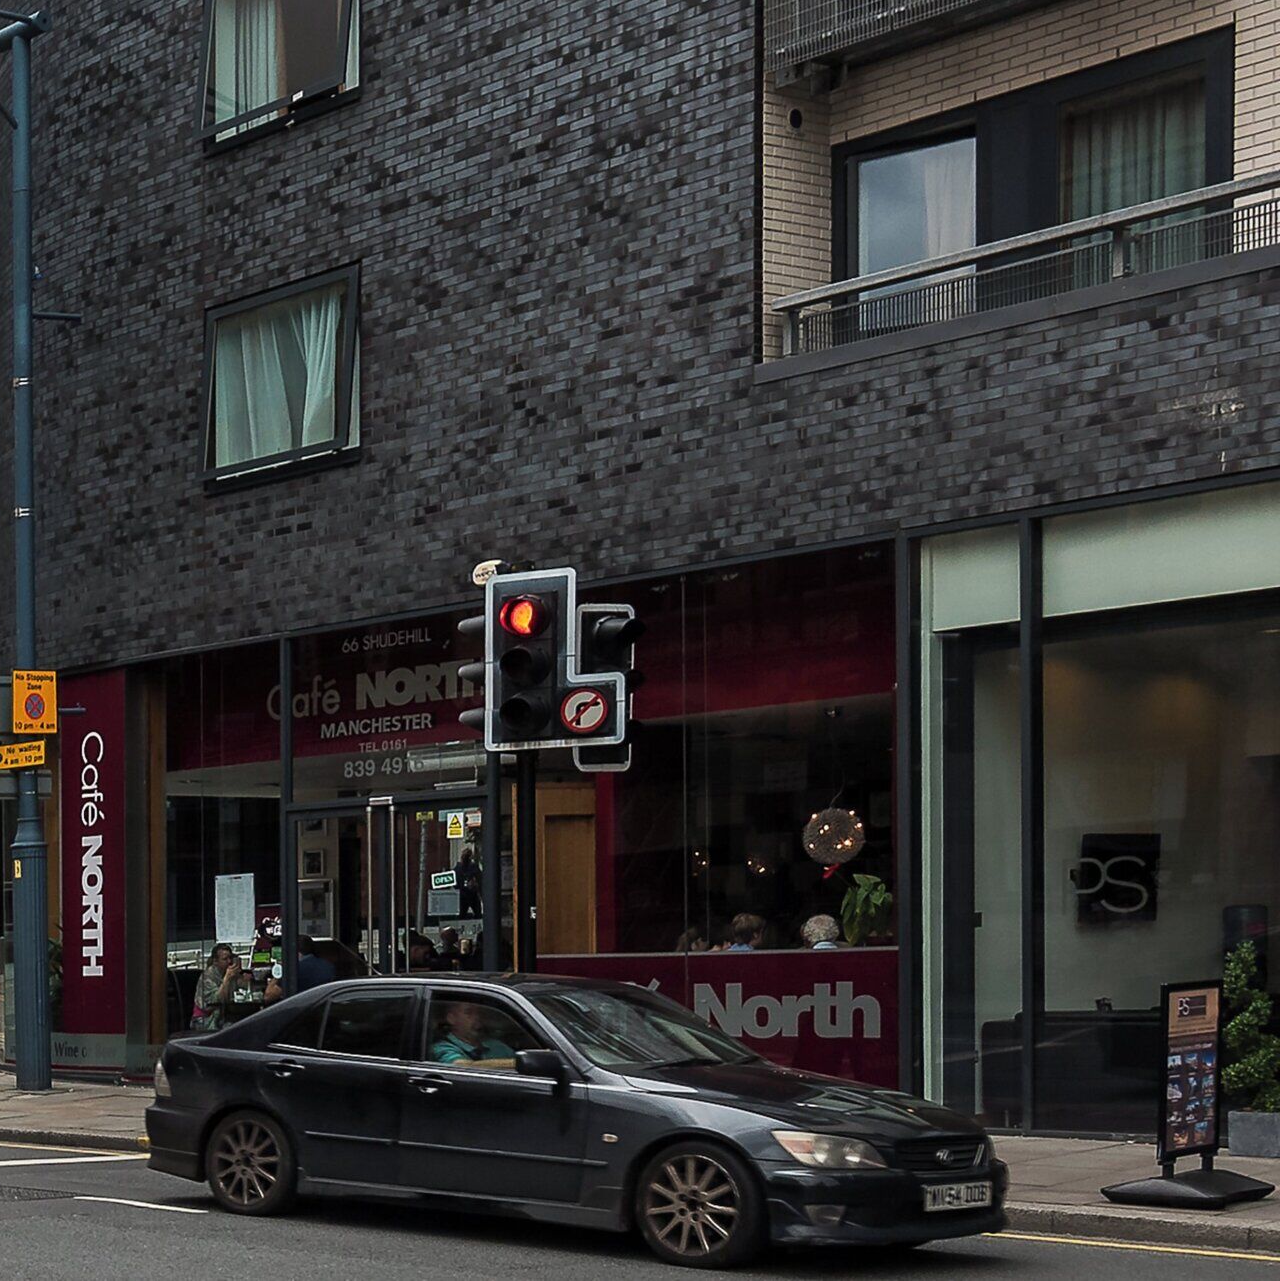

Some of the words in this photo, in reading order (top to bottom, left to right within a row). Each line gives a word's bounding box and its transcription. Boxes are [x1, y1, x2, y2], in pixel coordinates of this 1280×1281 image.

[341, 636, 359, 654] 66
[362, 626, 433, 652] SHUDEHILL
[15, 673, 25, 681] No
[26, 673, 54, 683] Stopping
[27, 683, 42, 691] Zone
[266, 674, 341, 721] Café
[355, 658, 485, 711] NORT
[14, 721, 22, 729] 10
[39, 721, 45, 729] 4
[320, 713, 433, 740] MANCHESTER
[6, 746, 15, 755] No
[18, 743, 42, 754] waiting
[358, 741, 379, 754] TEL
[381, 738, 408, 752] 0161
[343, 759, 376, 779] 839
[81, 730, 105, 827] Café
[434, 874, 454, 885] OPEN
[81, 835, 104, 977] NORTH
[693, 981, 882, 1039] North
[54, 1041, 80, 1058] Wine
